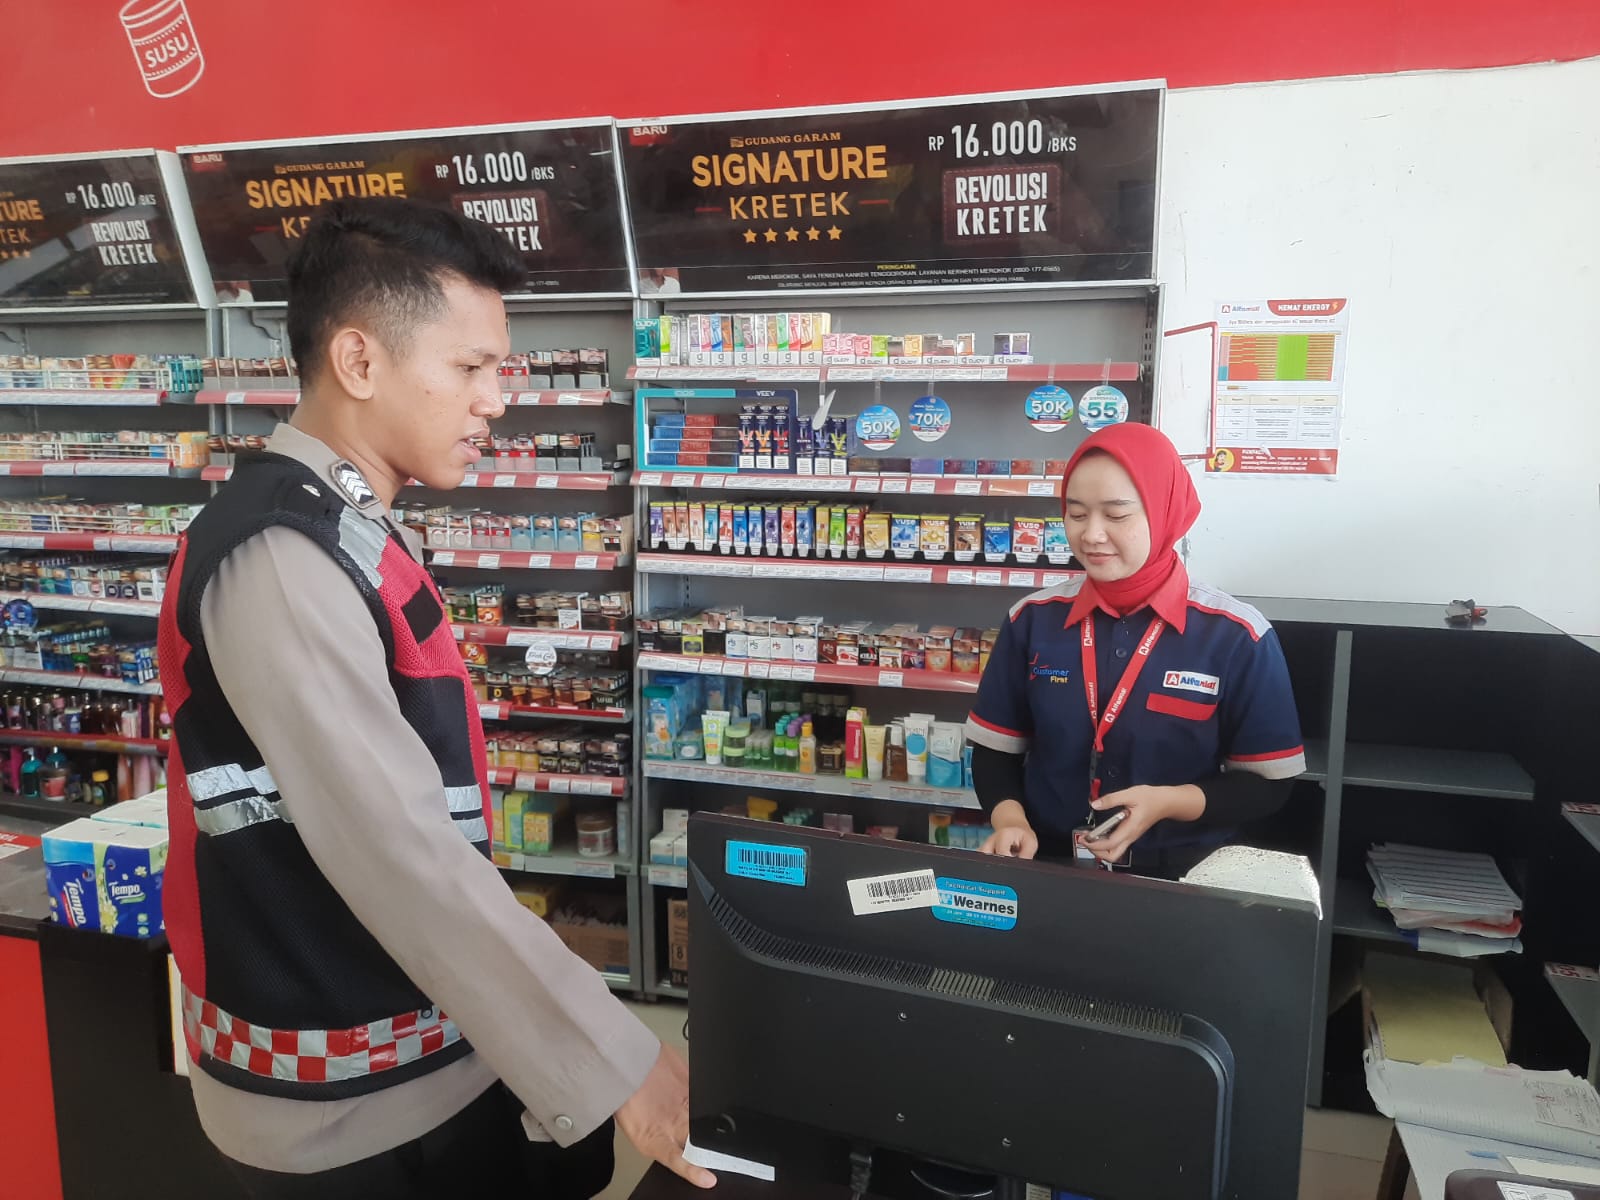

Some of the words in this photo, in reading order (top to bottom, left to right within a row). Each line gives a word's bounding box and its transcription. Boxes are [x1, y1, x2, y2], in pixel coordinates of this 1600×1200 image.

[145, 31, 189, 68] SUSU
[745, 135, 791, 146] GUDANG
[793, 132, 841, 143] GARAM
[928, 136, 945, 152] RP
[951, 119, 1043, 159] 16.000
[1047, 136, 1078, 153] /BKS
[326, 161, 365, 170] GARAM
[435, 164, 449, 179] RP
[452, 151, 527, 185] 16.000
[531, 166, 555, 181] /BKS
[691, 145, 888, 188] SIGNATURE
[77, 182, 136, 209] 16.000
[245, 172, 407, 209] SIGNATURE
[729, 192, 850, 220] KRETEK
[91, 219, 150, 243] REVOLUSI
[956, 204, 1048, 236] KRETEK
[98, 243, 159, 266] KRETEK
[1031, 400, 1067, 414] 50K
[862, 421, 895, 433] 50K
[915, 413, 943, 425] 70K
[1033, 667, 1070, 677] Customer
[1050, 675, 1068, 683] First
[108, 881, 141, 897] Tempo
[945, 880, 977, 891] Technical
[979, 885, 1006, 895] Support
[65, 878, 87, 925] Tempo
[953, 895, 1015, 915] Wearnes
